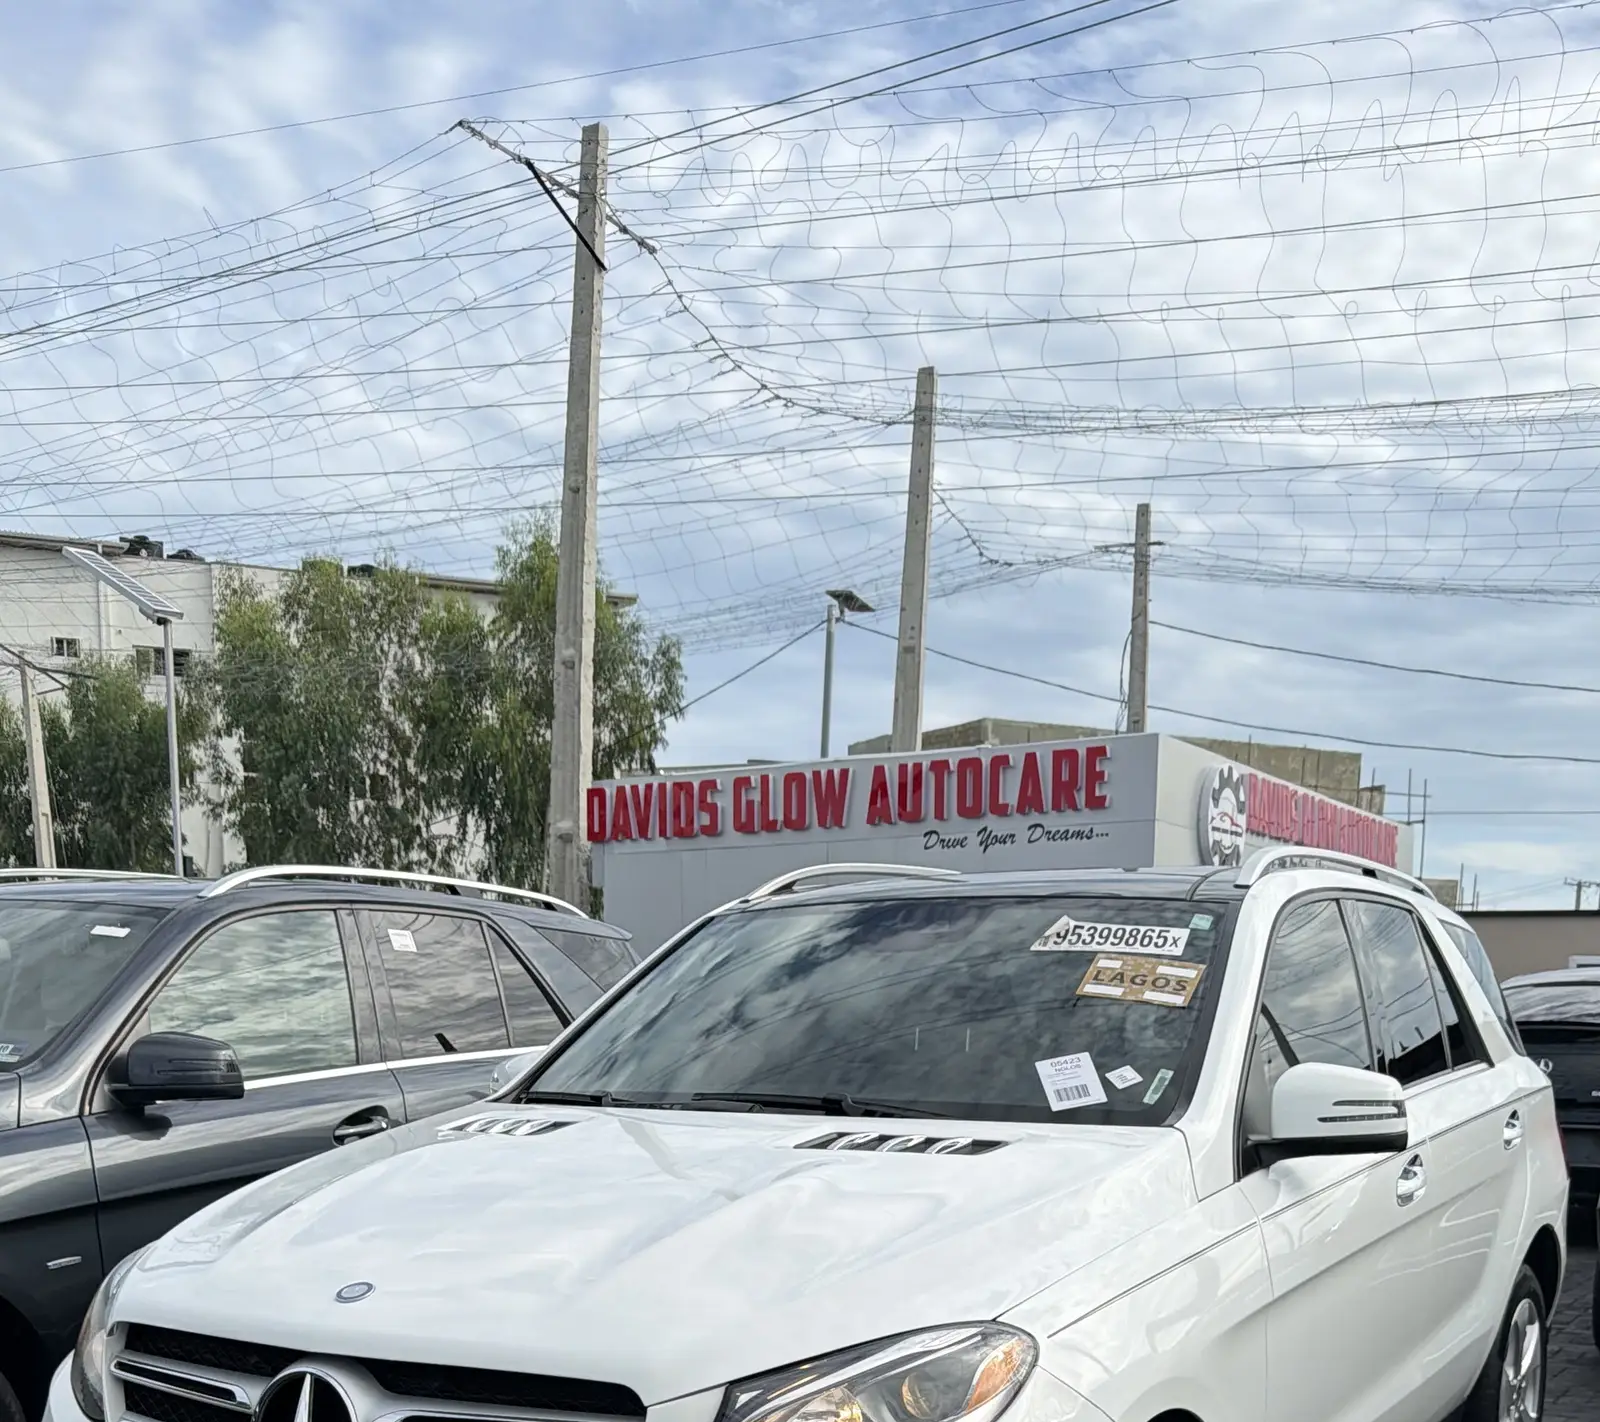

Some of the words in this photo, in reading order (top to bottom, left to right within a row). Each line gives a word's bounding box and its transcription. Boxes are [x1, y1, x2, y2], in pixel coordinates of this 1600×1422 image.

[586, 778, 721, 842] DAVIDS
[732, 767, 852, 834] GLOW
[866, 745, 1109, 826] AUTOCARE
[923, 830, 968, 850] Drive
[976, 825, 1017, 854] Your
[1092, 969, 1188, 992] LAGOS
